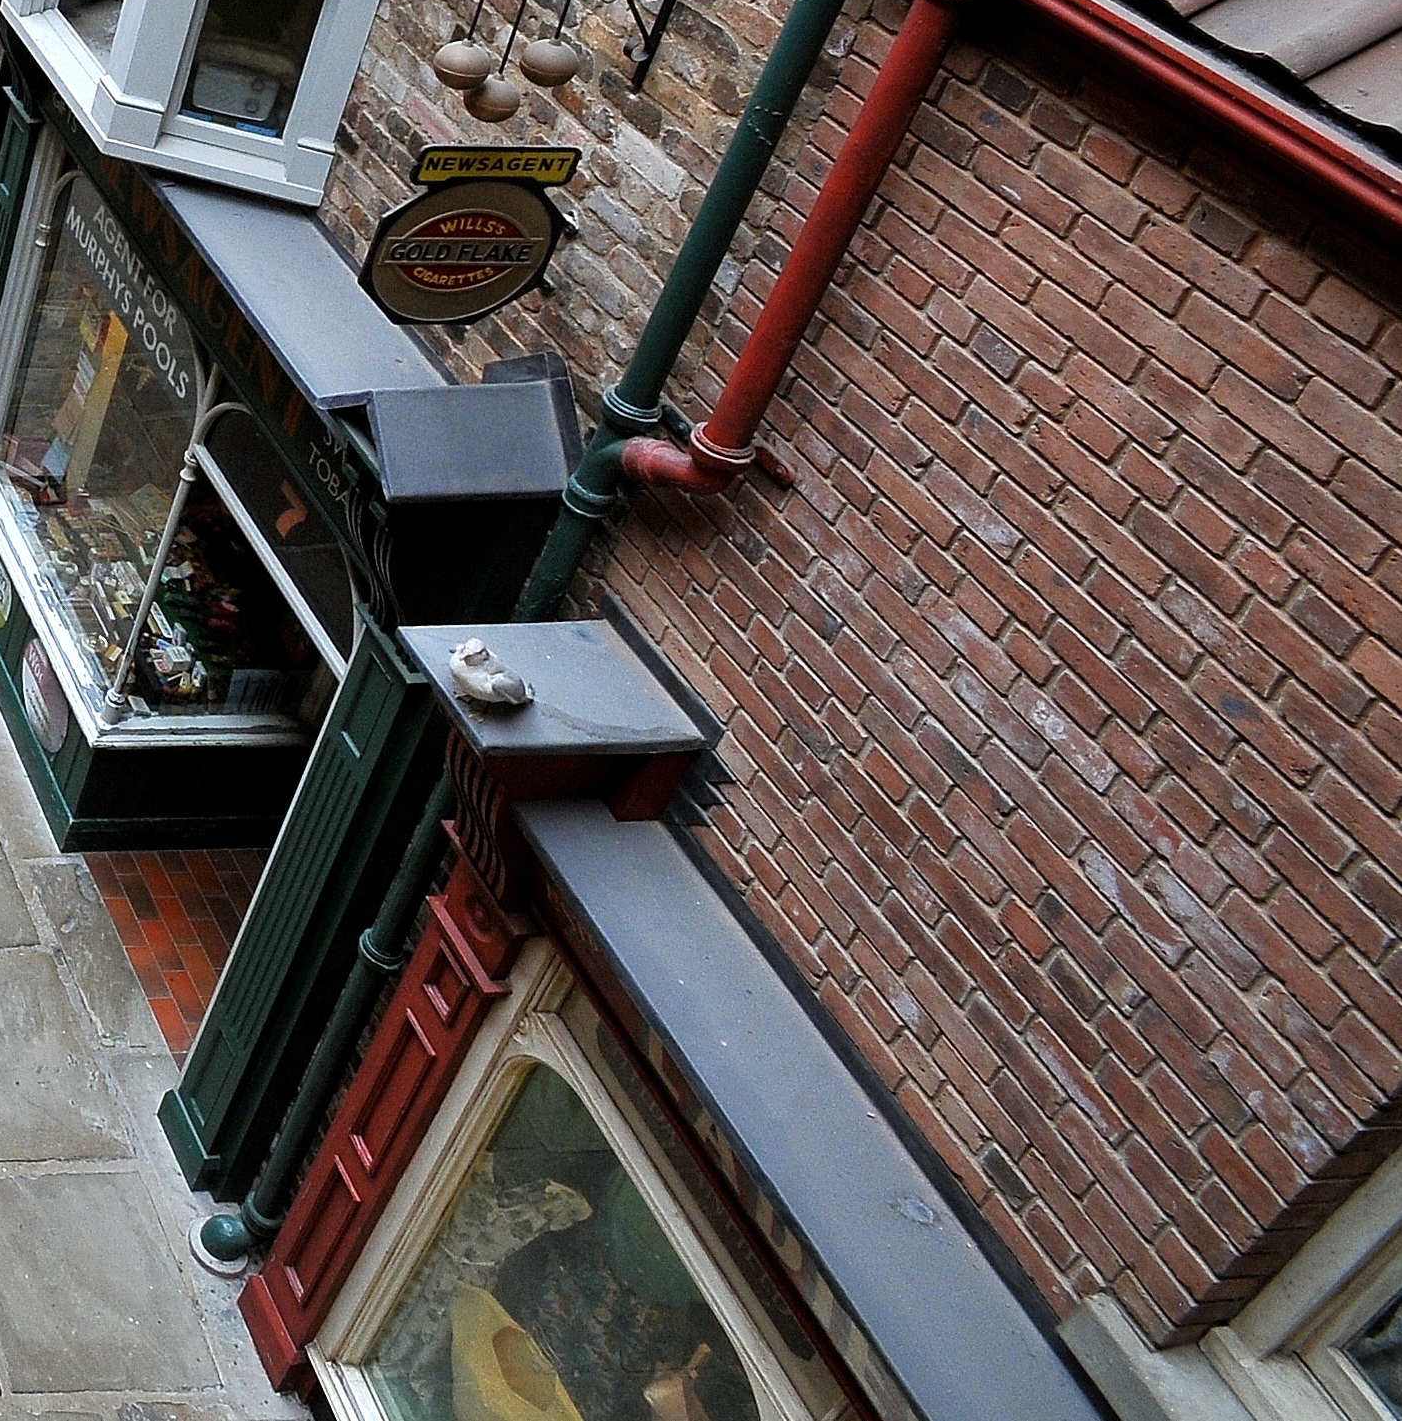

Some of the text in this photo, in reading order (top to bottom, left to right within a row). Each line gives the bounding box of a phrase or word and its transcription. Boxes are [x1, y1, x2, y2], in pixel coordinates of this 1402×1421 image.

[425, 157, 571, 172] NEWSAGENT
[390, 244, 533, 262] GOLD FLAKE
[92, 205, 179, 336] AGENT FOR
[413, 266, 494, 286] CIGARETTES
[66, 205, 189, 399] MURPHYS POOLS
